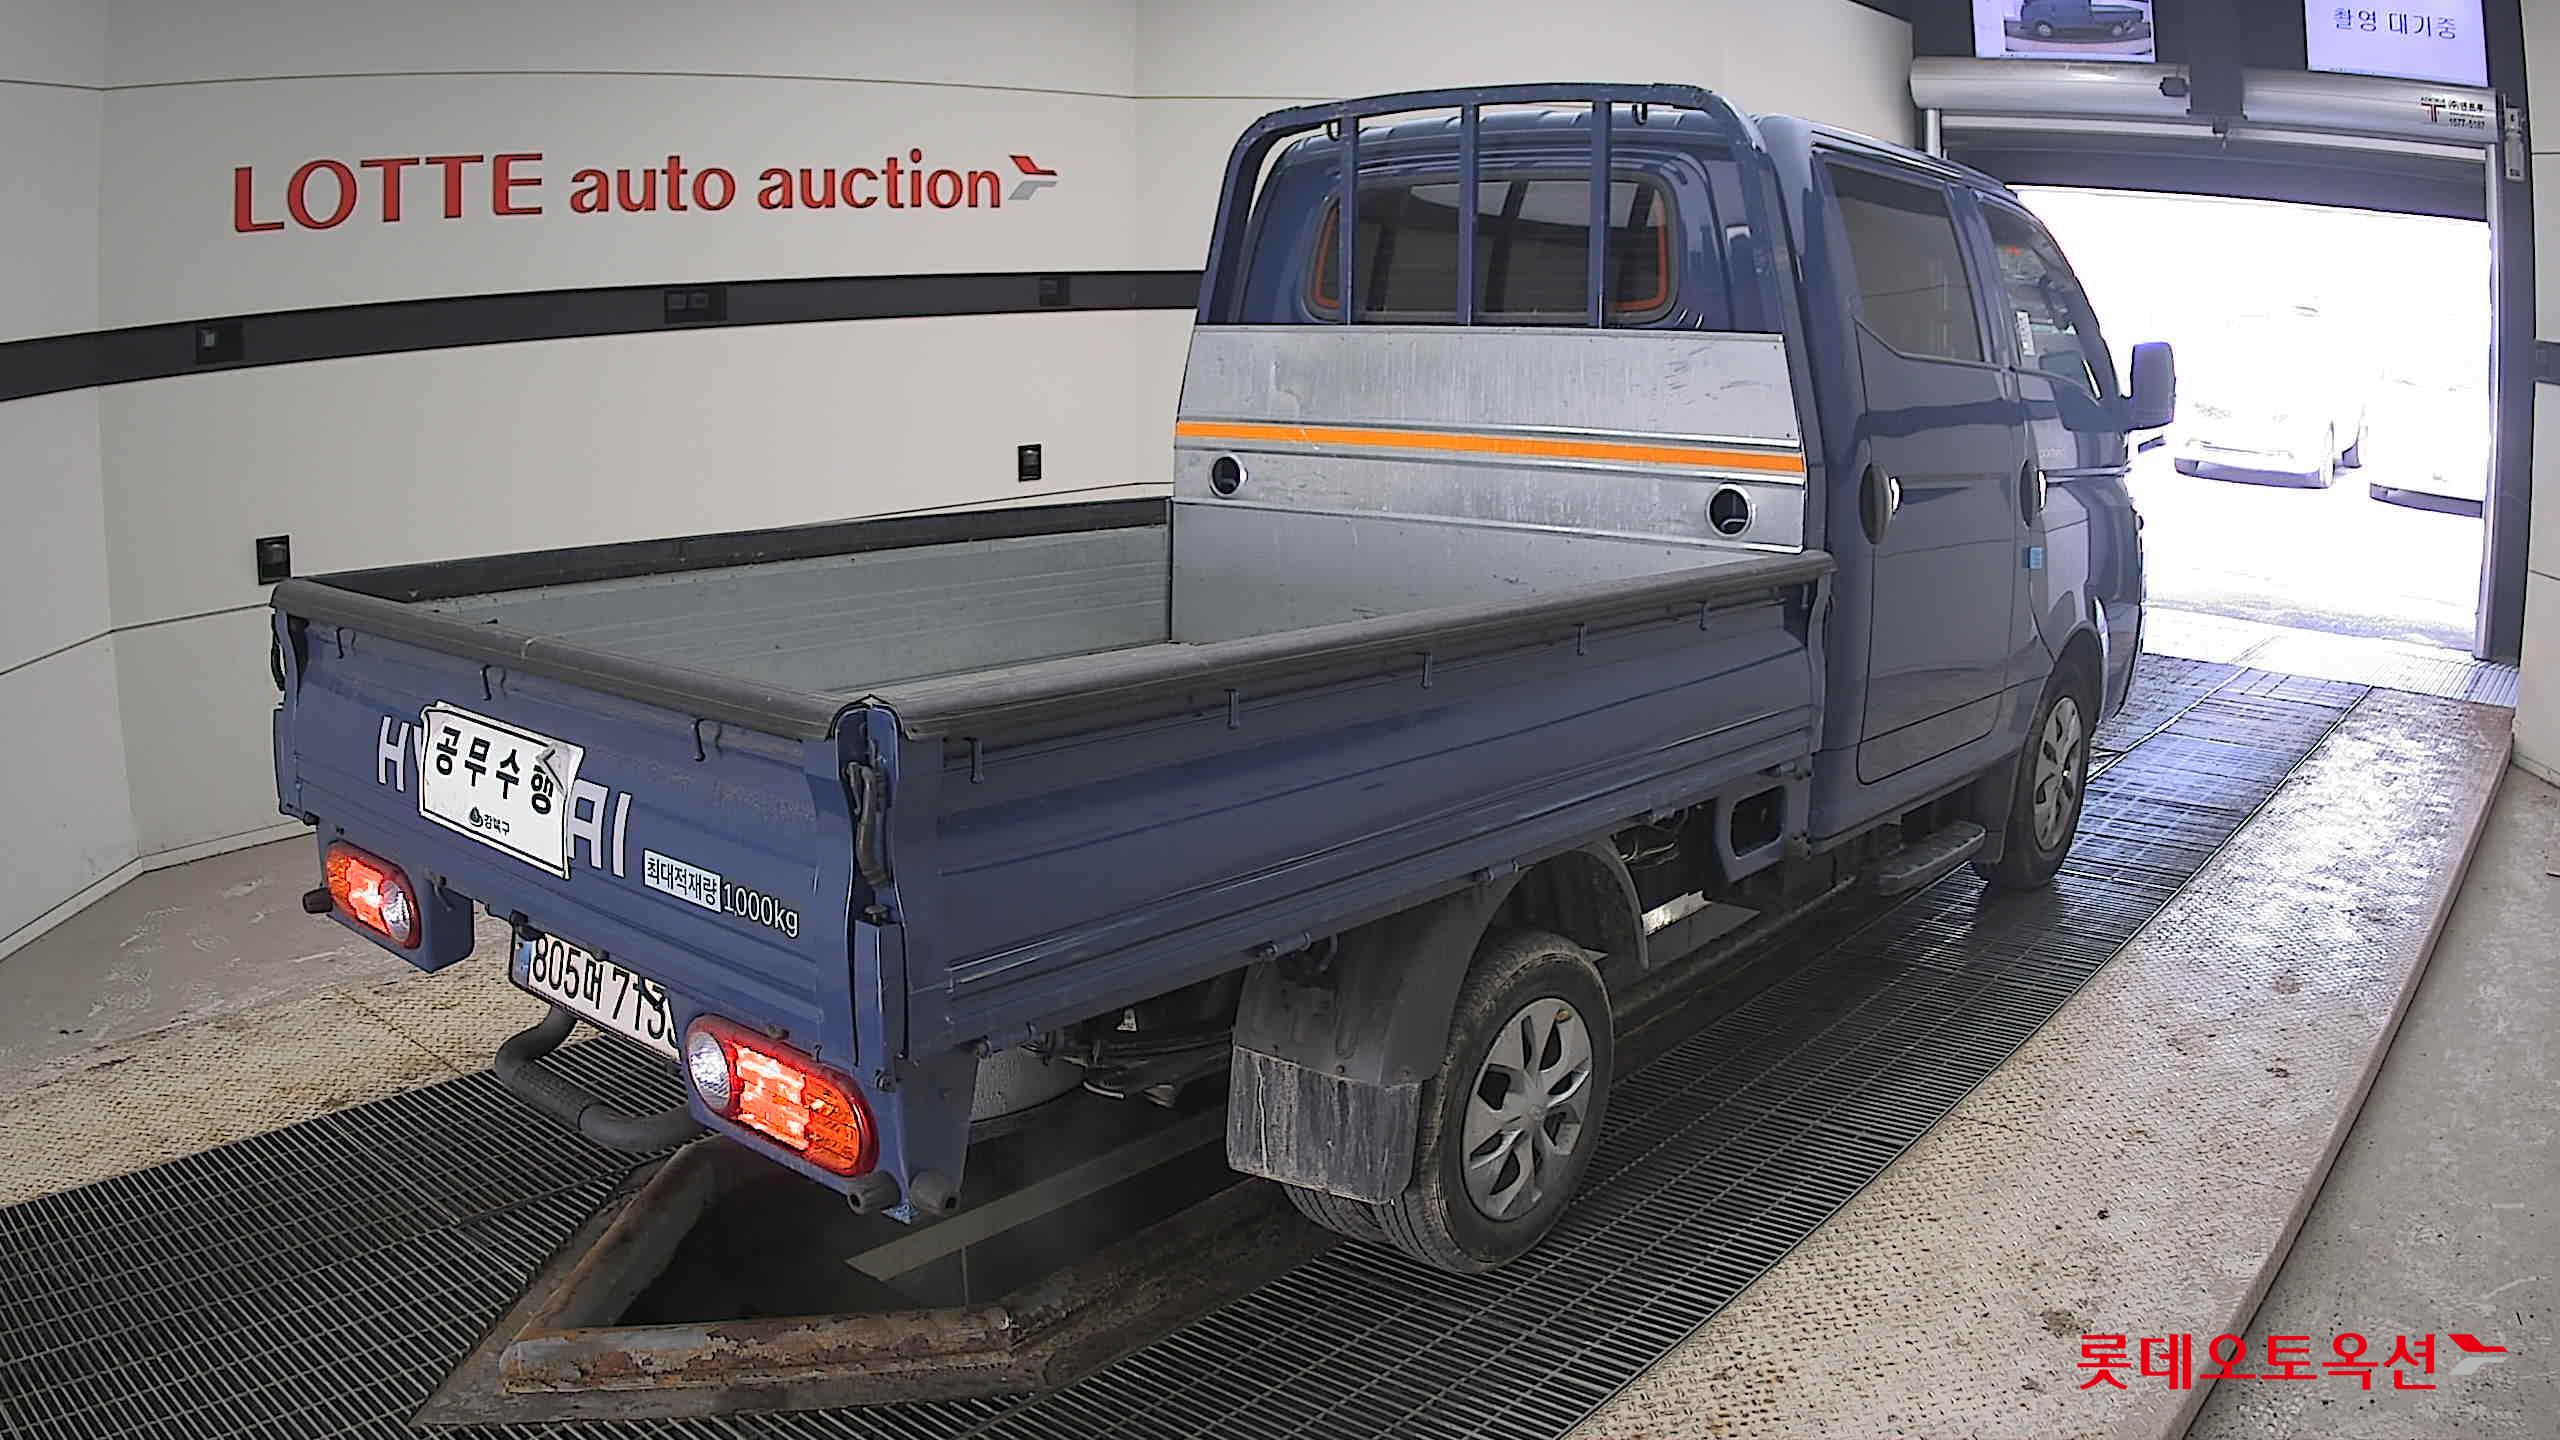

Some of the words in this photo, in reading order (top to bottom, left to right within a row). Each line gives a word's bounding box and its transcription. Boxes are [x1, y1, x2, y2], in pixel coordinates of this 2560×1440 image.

[2388, 13, 2456, 40] 대기중
[234, 153, 541, 233] LOTTE
[570, 157, 737, 214] auto
[756, 150, 1002, 211] auction
[436, 726, 554, 815] 공무수행
[647, 857, 718, 906] 최대적재량
